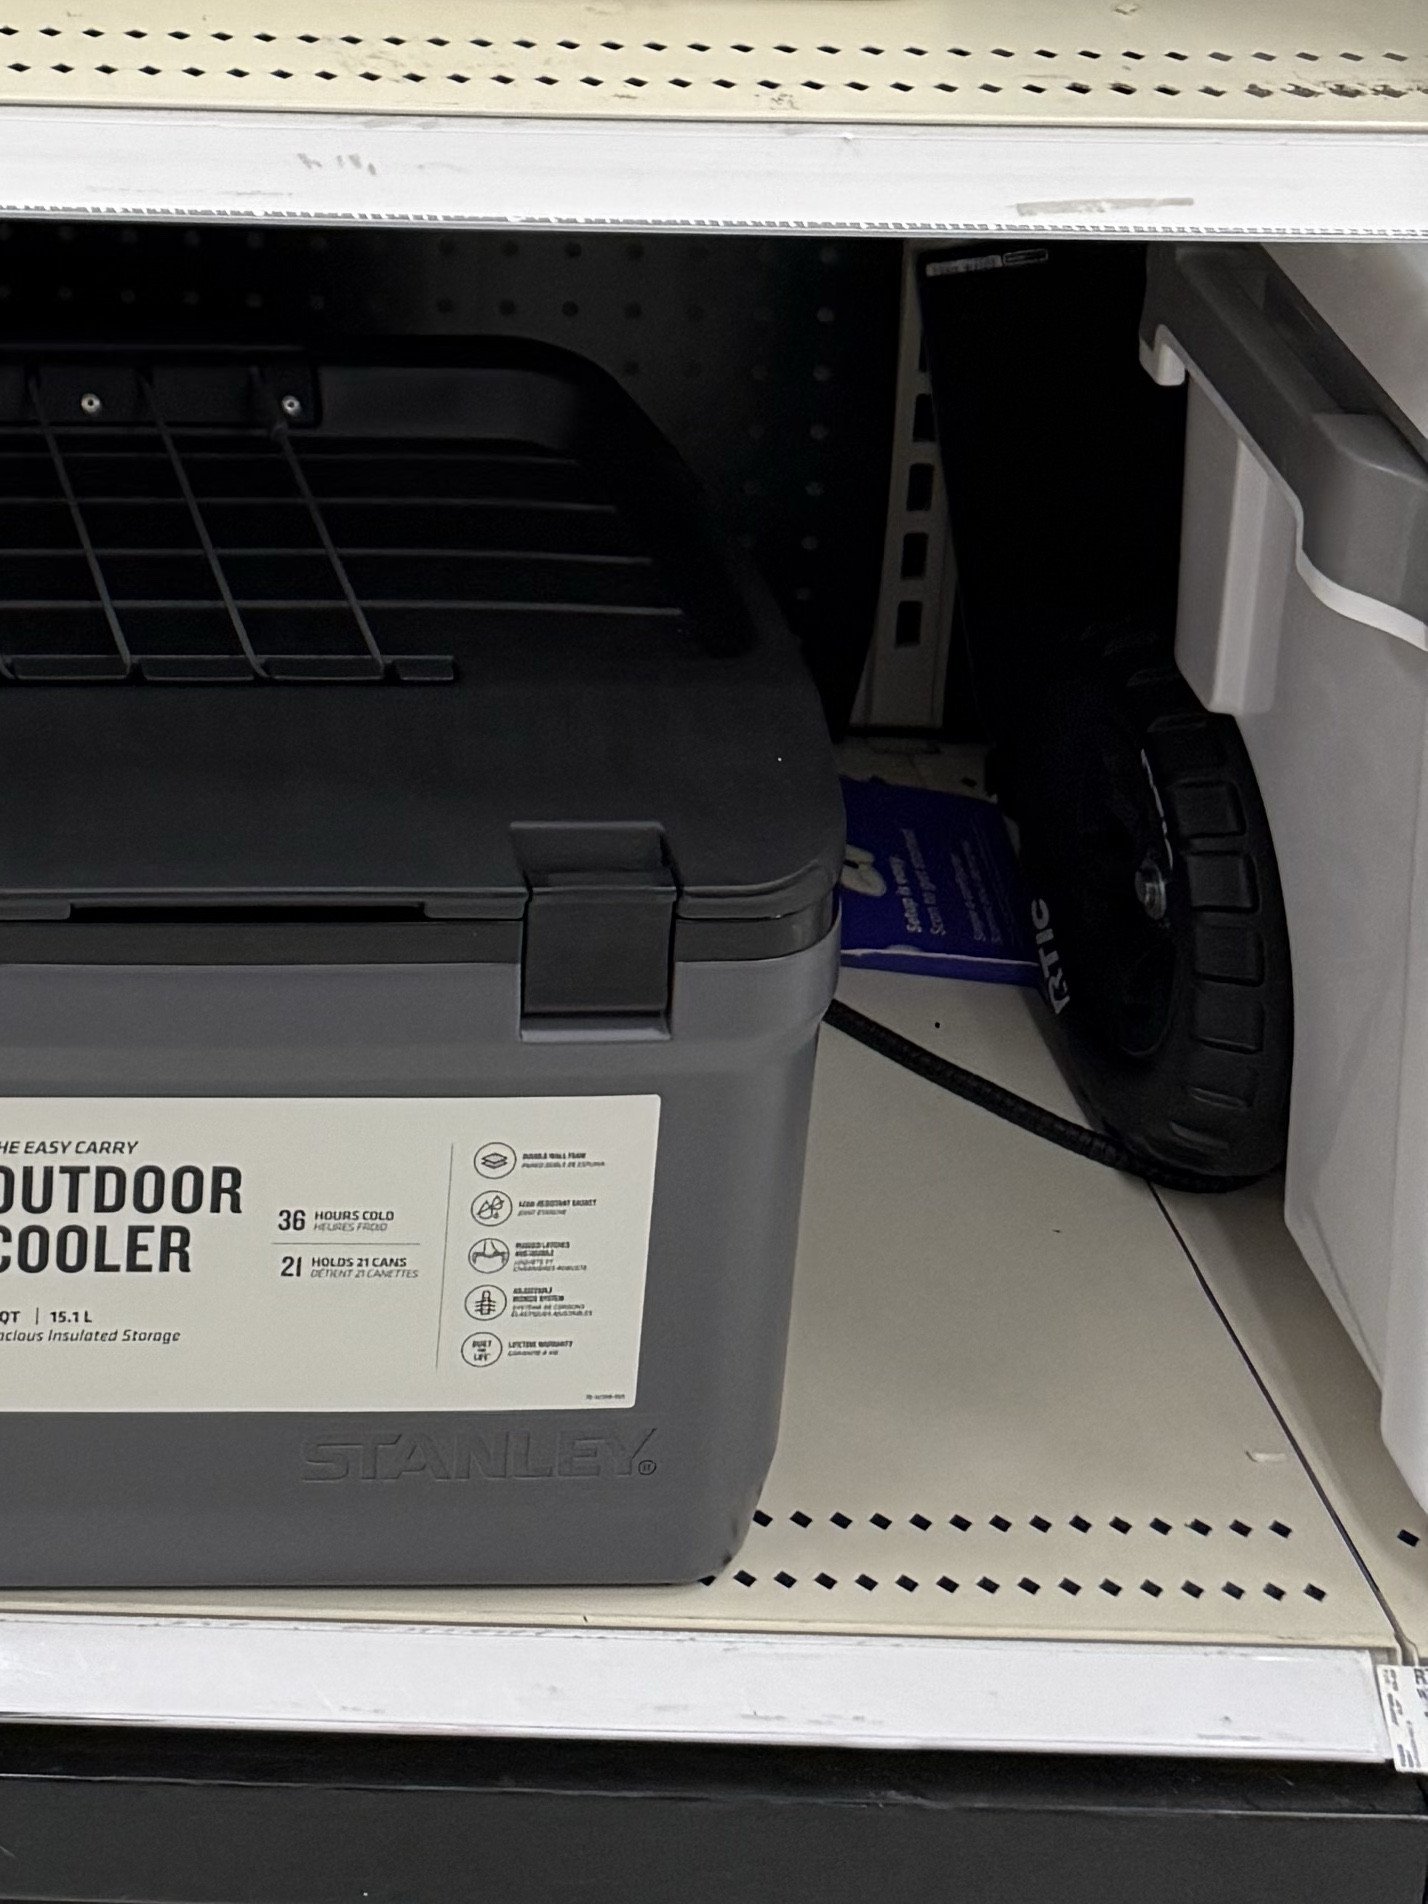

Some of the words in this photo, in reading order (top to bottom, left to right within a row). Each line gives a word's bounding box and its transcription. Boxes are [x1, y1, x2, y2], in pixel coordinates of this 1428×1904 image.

[1030, 897, 1072, 1015] RTIC
[24, 1139, 72, 1155] EASY
[75, 1139, 139, 1155] CARRY
[278, 1209, 306, 1231] 36
[314, 1210, 360, 1221] HOURS
[362, 1210, 394, 1221] COLD
[280, 1255, 303, 1277] 21
[311, 1257, 354, 1267] HOLDS
[357, 1257, 369, 1267] 21
[372, 1257, 407, 1268] CANS
[49, 1309, 80, 1324] 15.1
[83, 1310, 93, 1323] L
[48, 1328, 118, 1343] Insulated
[122, 1328, 181, 1344] Storage
[302, 1428, 658, 1482] STANLEY
